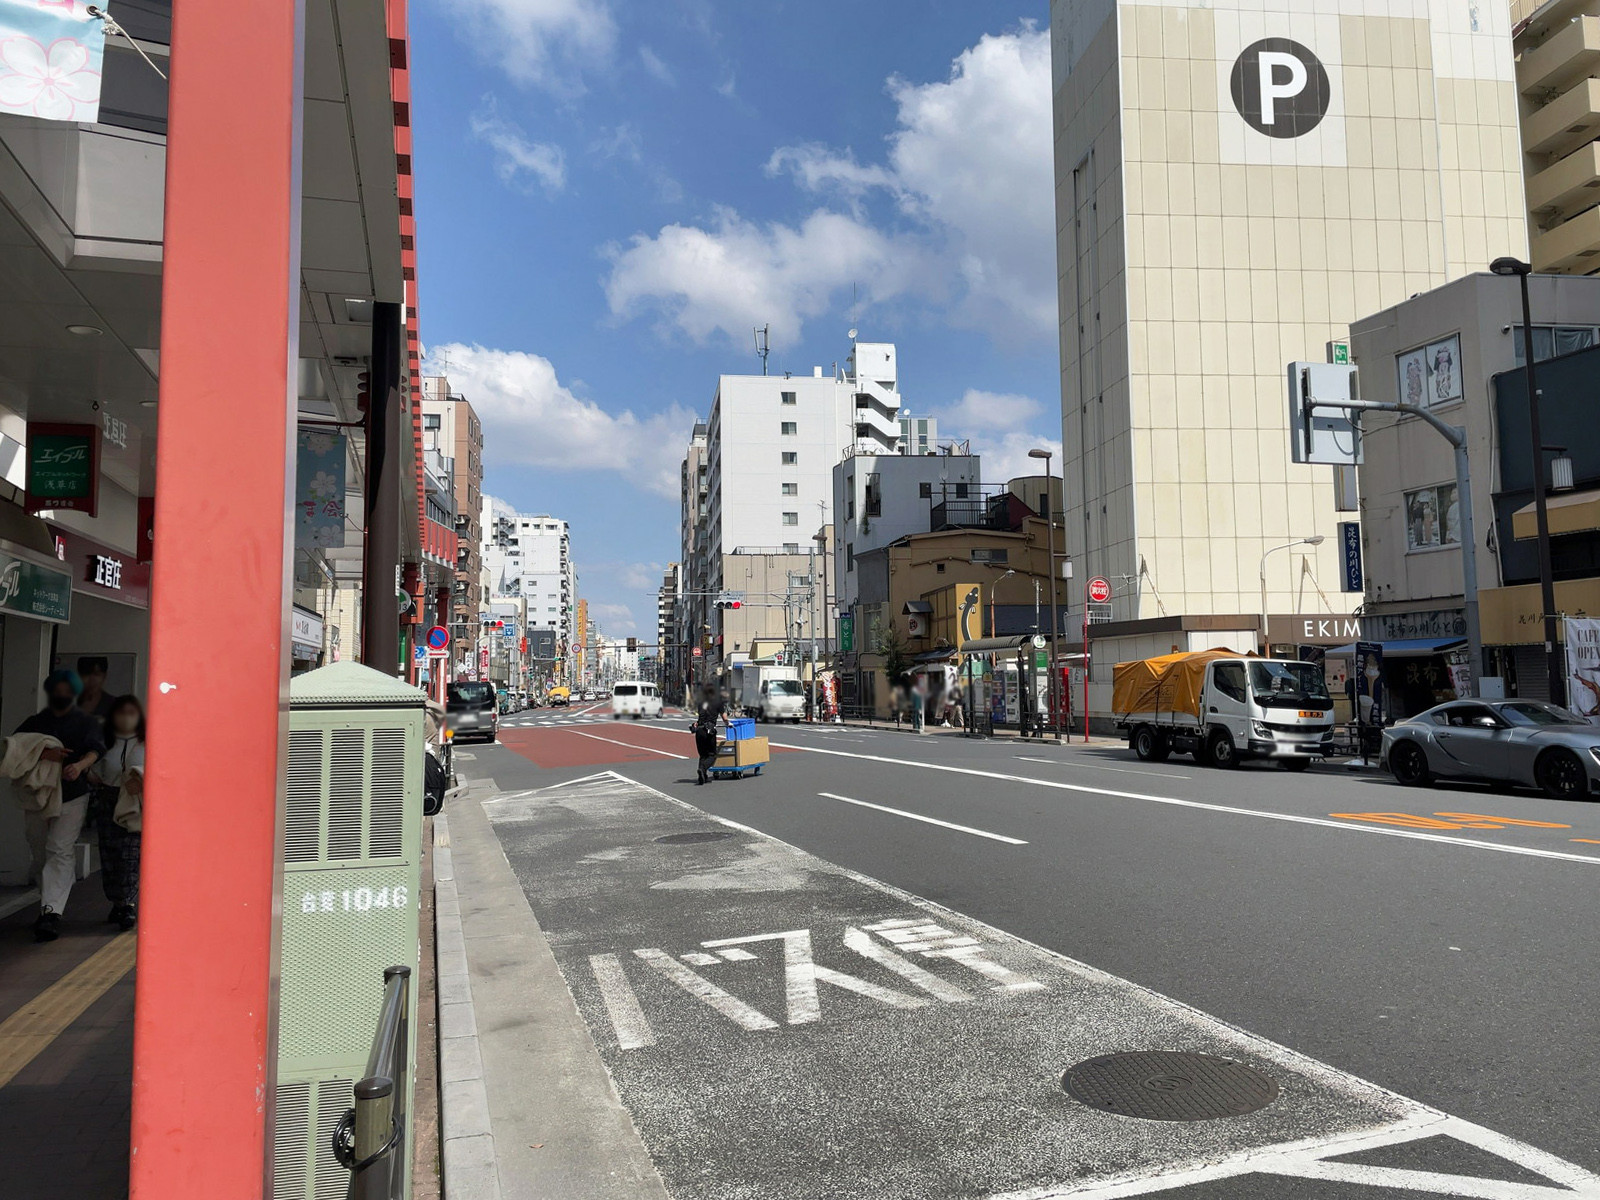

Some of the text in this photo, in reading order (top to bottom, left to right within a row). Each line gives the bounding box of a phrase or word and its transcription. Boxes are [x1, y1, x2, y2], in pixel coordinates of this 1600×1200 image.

[1258, 51, 1308, 125] P
[34, 445, 88, 464] エイブル
[0, 561, 21, 606] ブル
